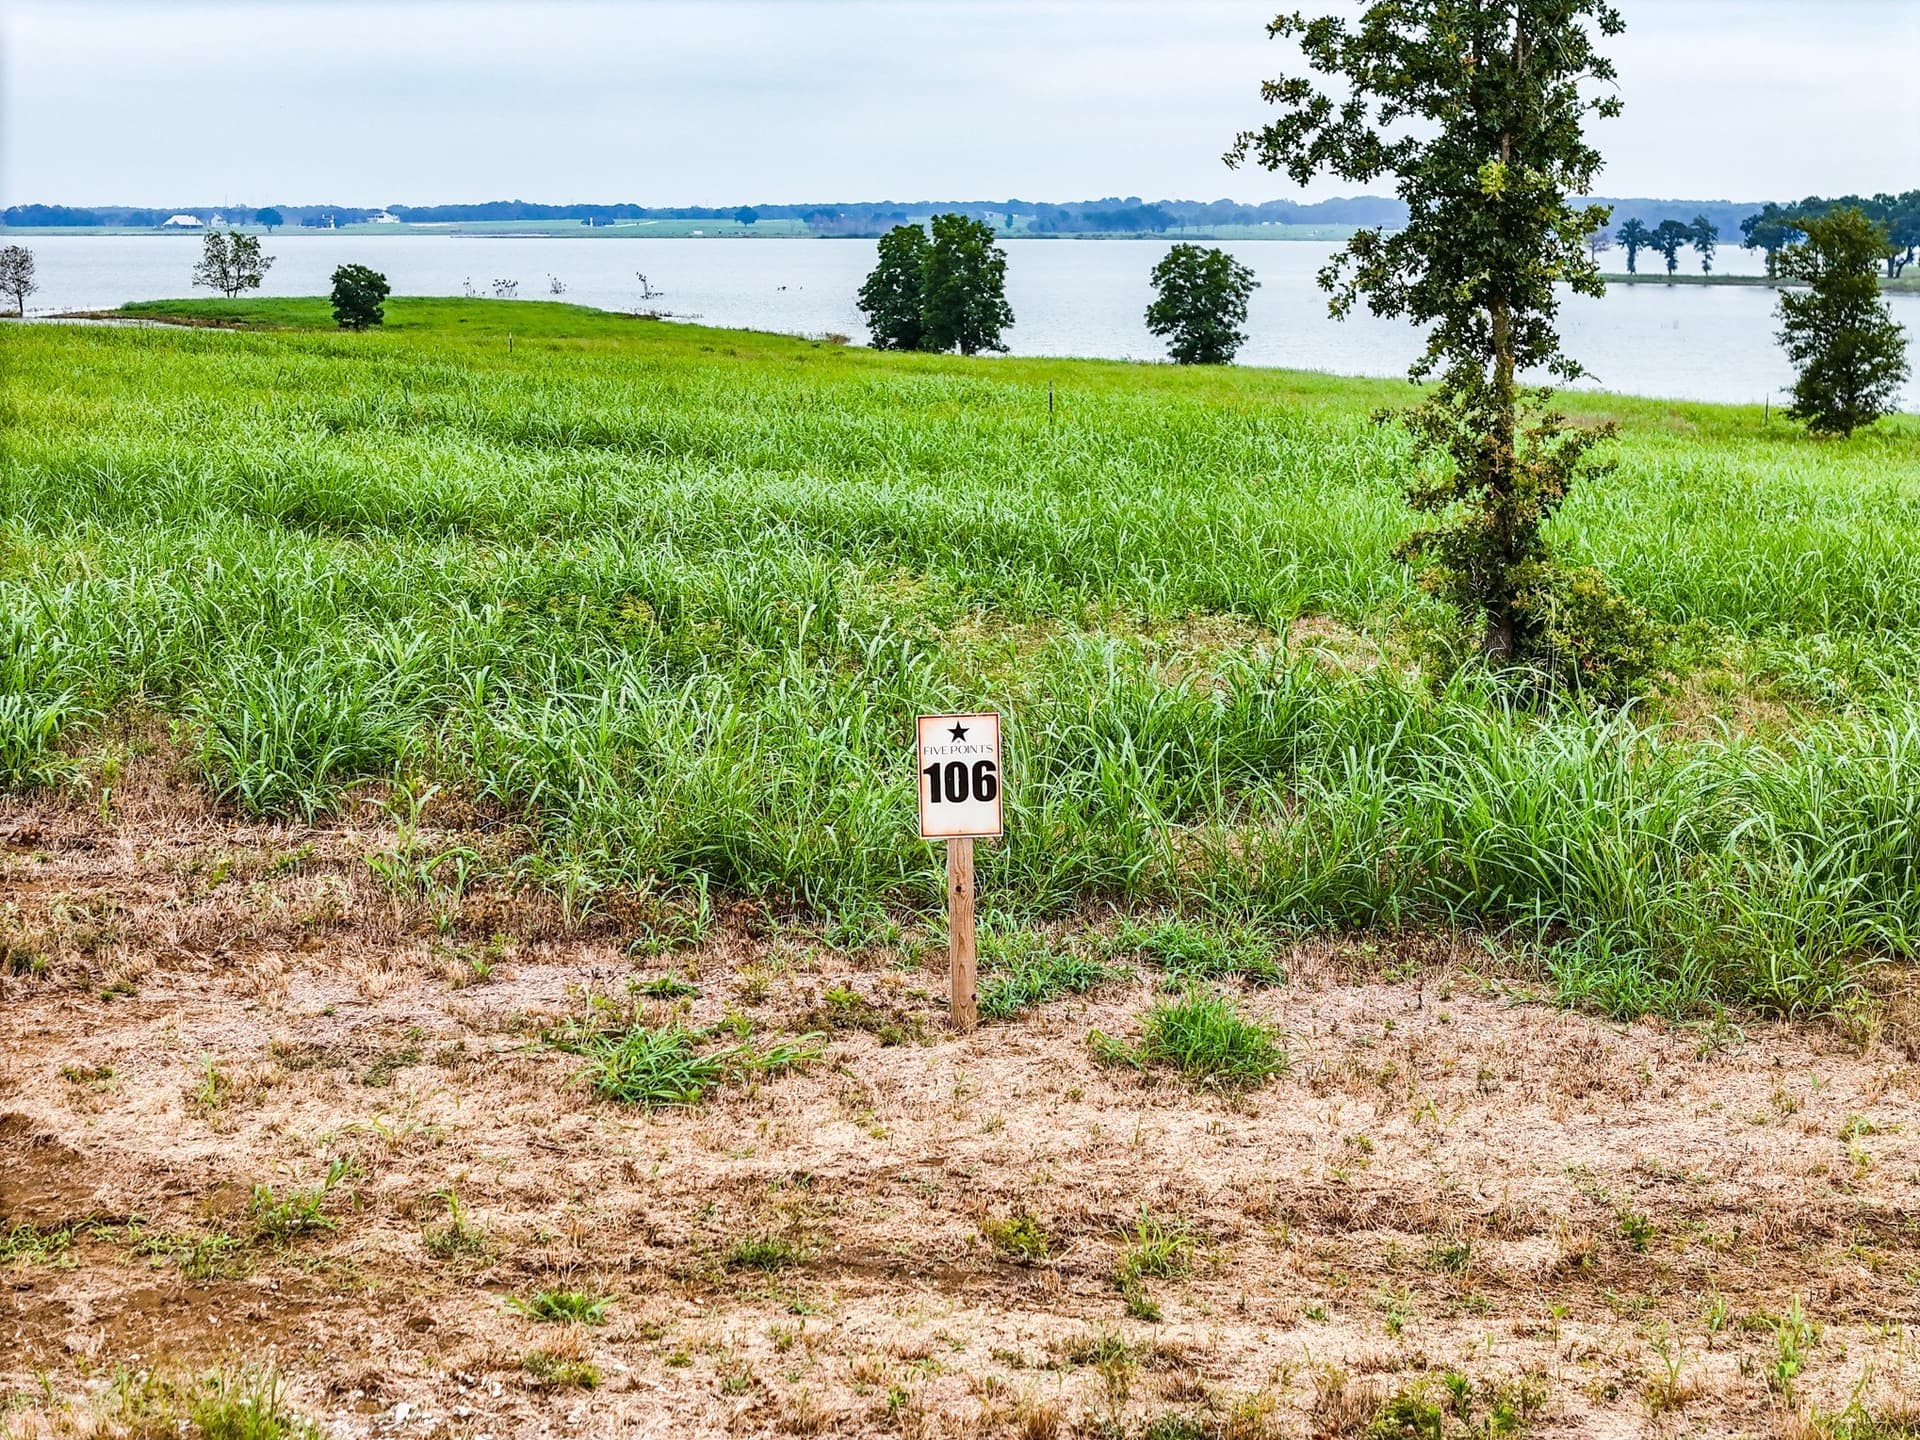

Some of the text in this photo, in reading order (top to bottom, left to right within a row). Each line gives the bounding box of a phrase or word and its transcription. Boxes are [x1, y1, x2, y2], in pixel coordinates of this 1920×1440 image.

[923, 744, 994, 755] FIVE POINTS
[923, 760, 997, 803] 106
